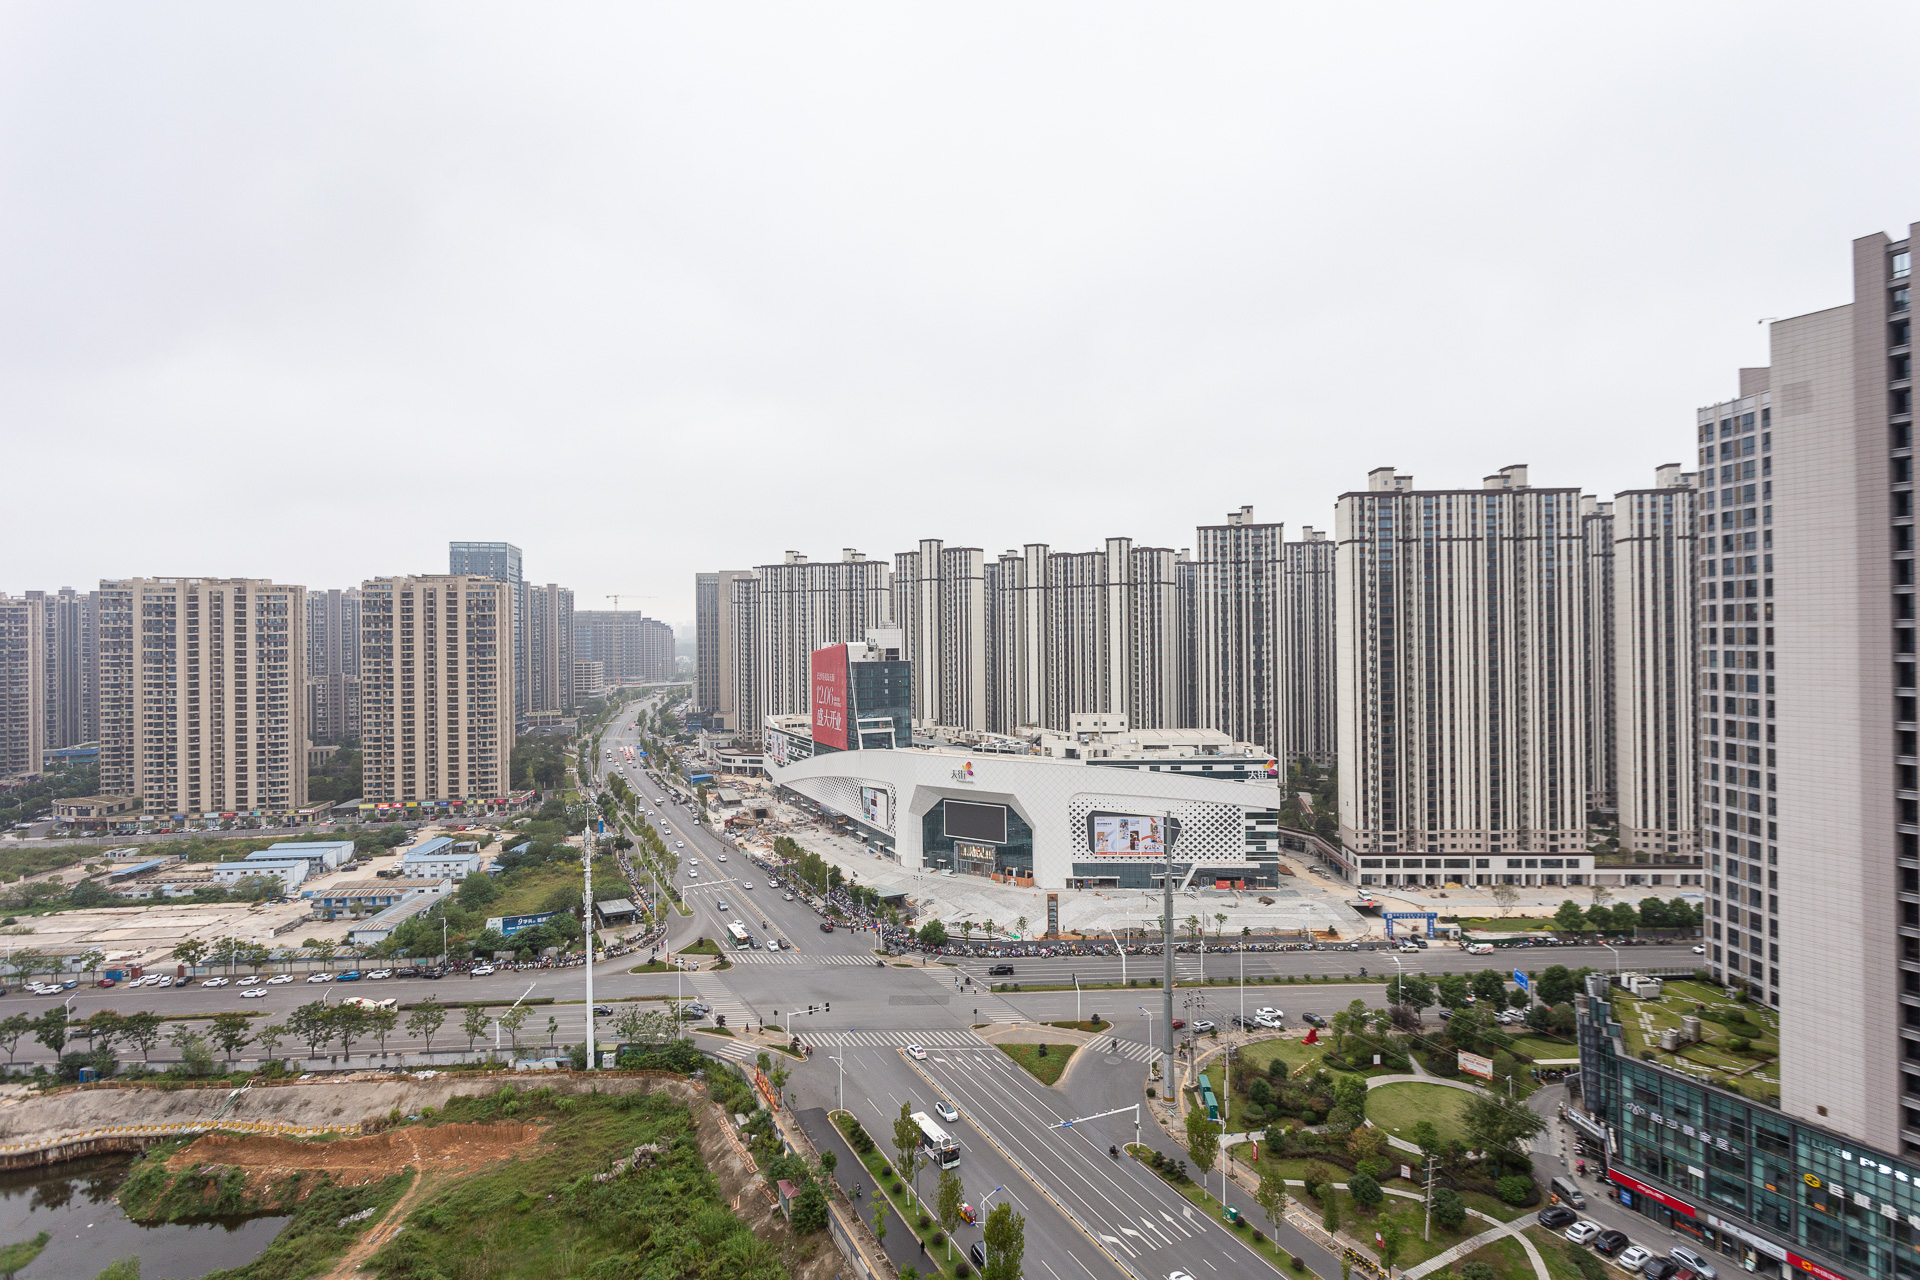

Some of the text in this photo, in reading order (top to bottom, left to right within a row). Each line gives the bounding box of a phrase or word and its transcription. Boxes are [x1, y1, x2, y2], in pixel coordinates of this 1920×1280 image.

[816, 707, 842, 732] 盛大开业
[951, 769, 966, 780] 天街
[1247, 769, 1268, 780] 天街
